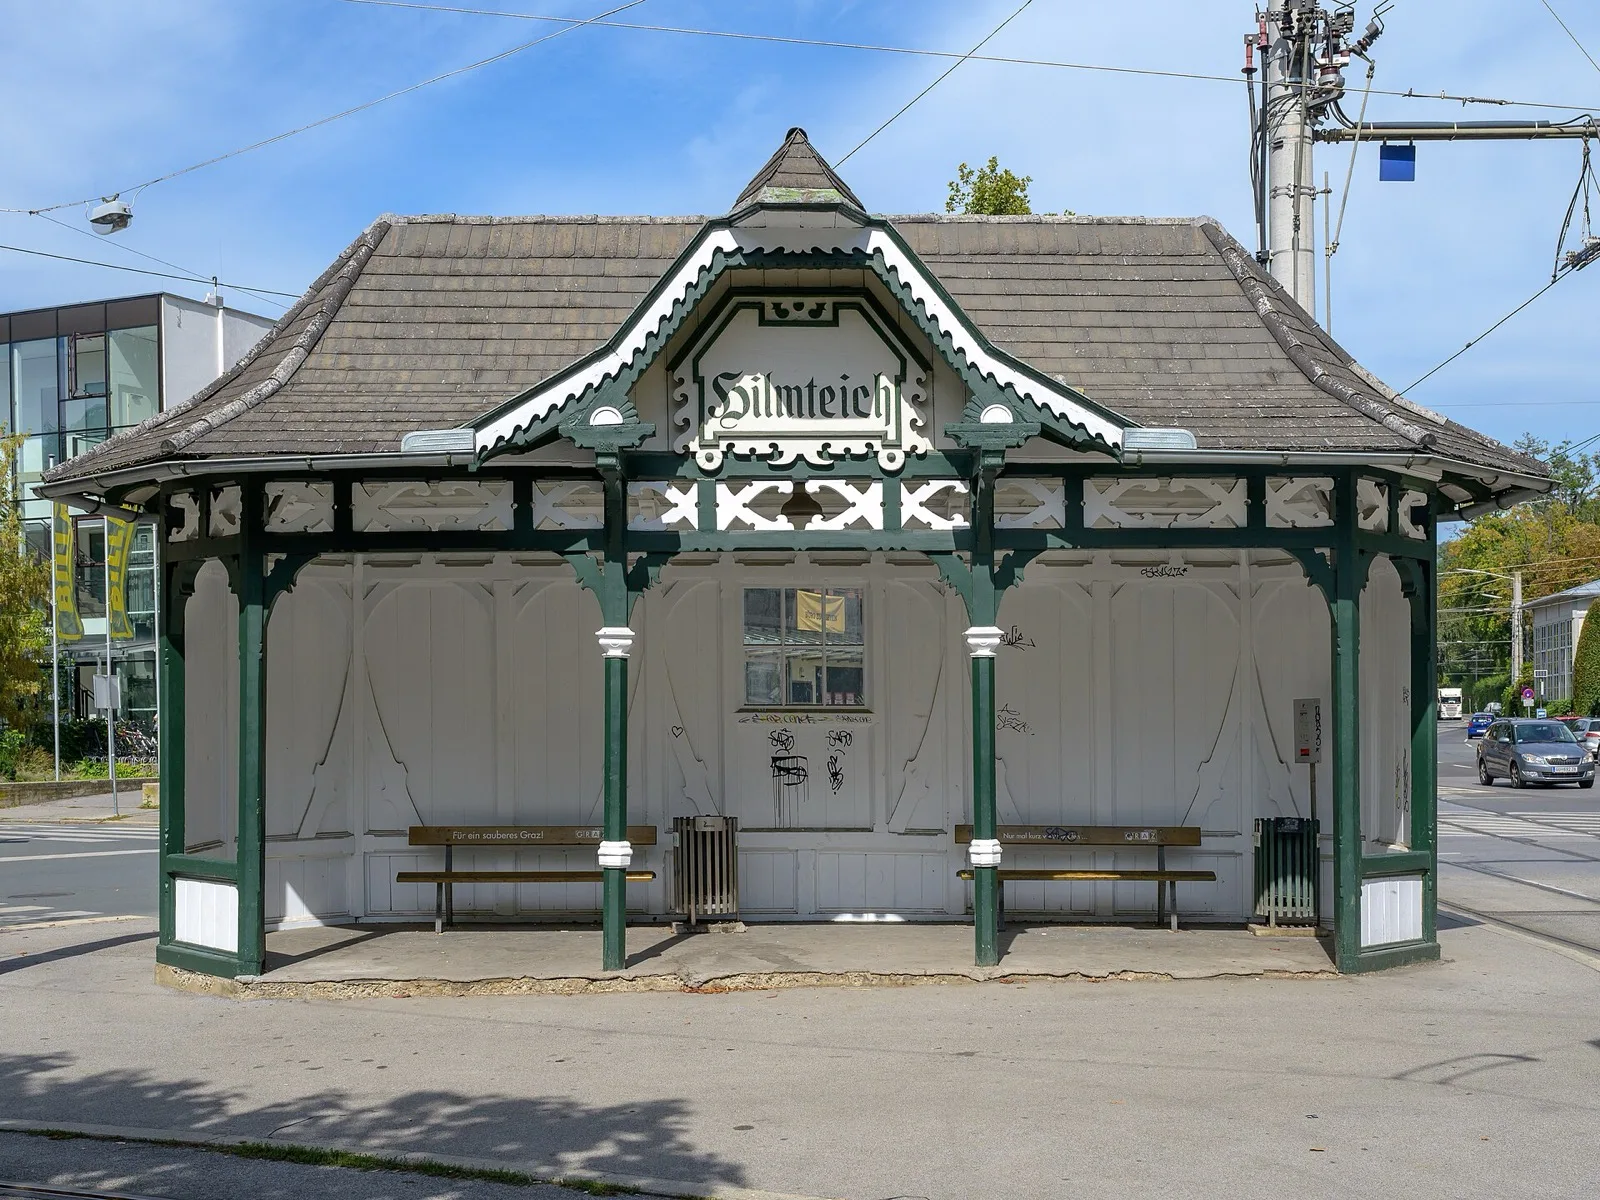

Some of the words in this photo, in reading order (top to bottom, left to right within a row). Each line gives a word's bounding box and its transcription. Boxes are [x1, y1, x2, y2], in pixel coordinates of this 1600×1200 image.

[452, 831, 466, 840] Für
[467, 831, 480, 840] ein
[482, 830, 518, 840] sauberes
[519, 830, 544, 840] Graz!
[576, 830, 604, 838] GRA
[1003, 832, 1015, 840] Nur
[1016, 832, 1028, 840] mal
[1028, 832, 1042, 840] kurz
